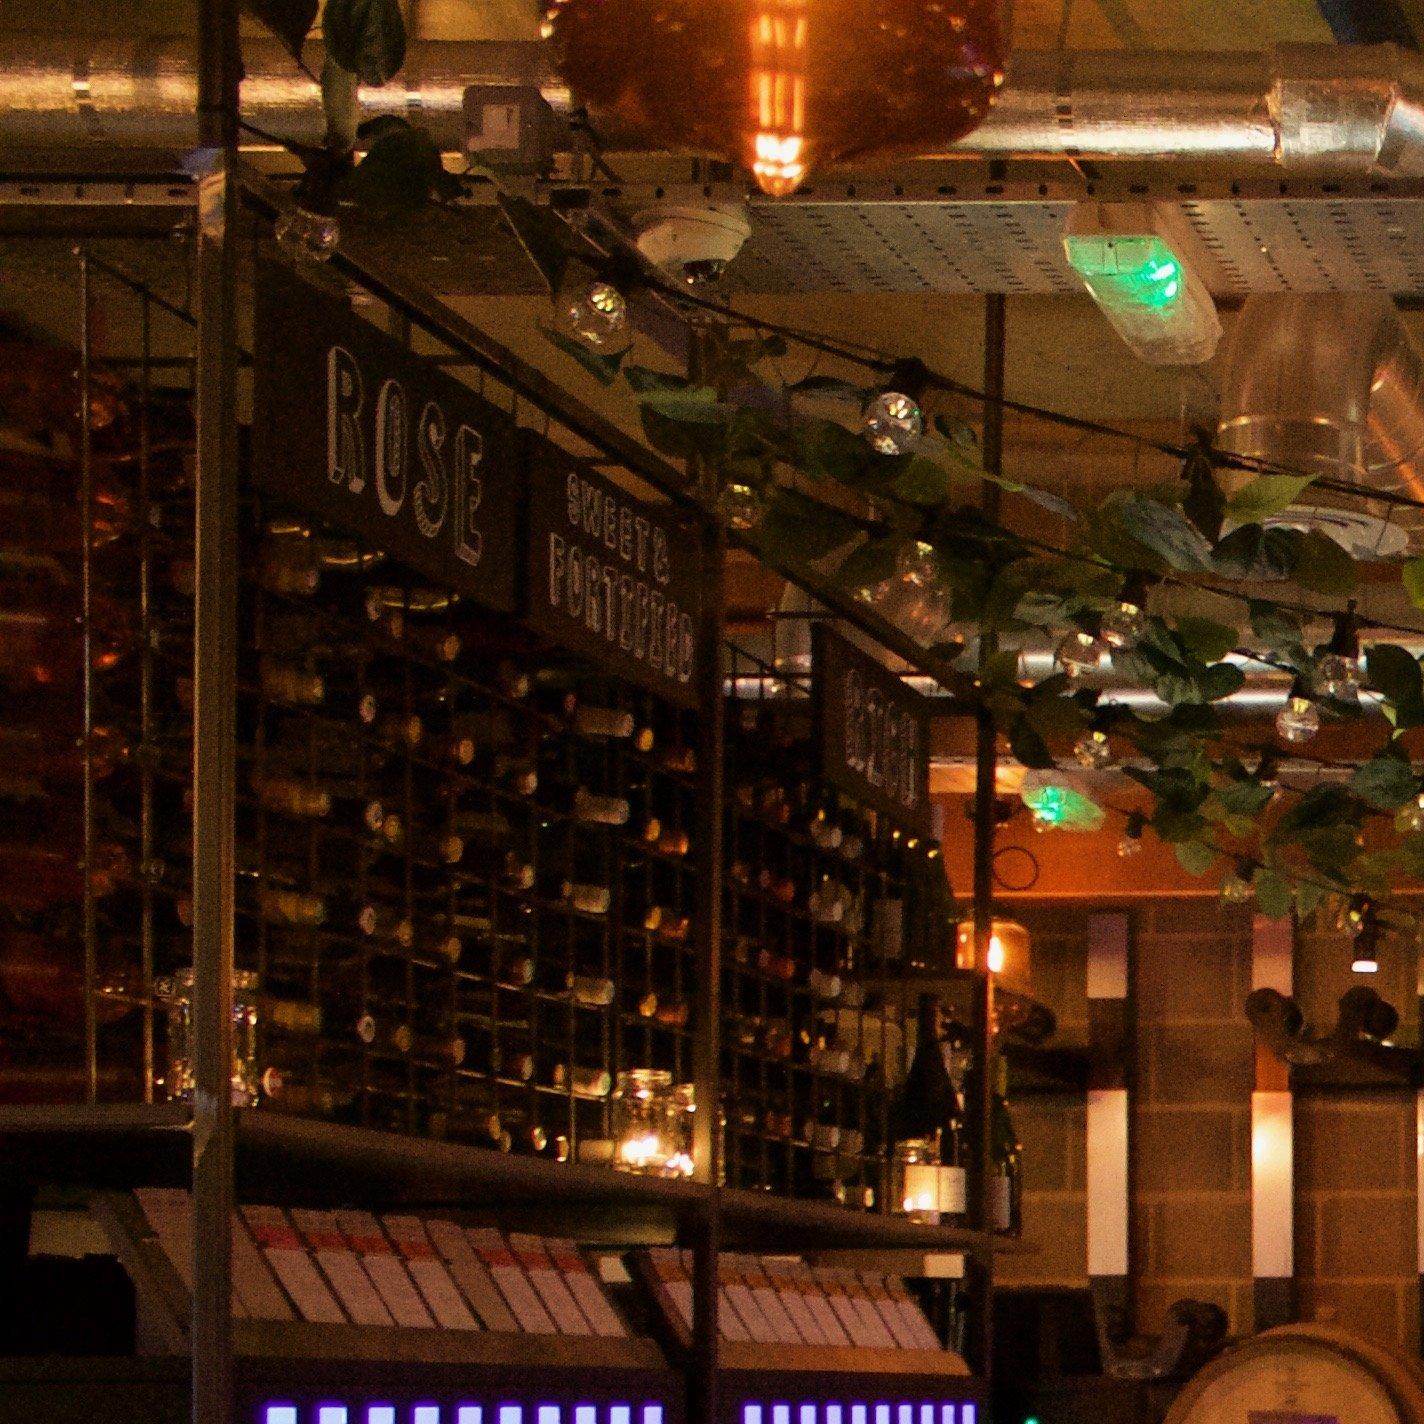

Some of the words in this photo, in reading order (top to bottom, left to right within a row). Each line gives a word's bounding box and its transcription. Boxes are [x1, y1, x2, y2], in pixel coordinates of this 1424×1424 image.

[326, 345, 483, 566] ROSE
[566, 472, 651, 573] SWEET
[548, 531, 694, 684] FORTIFIED
